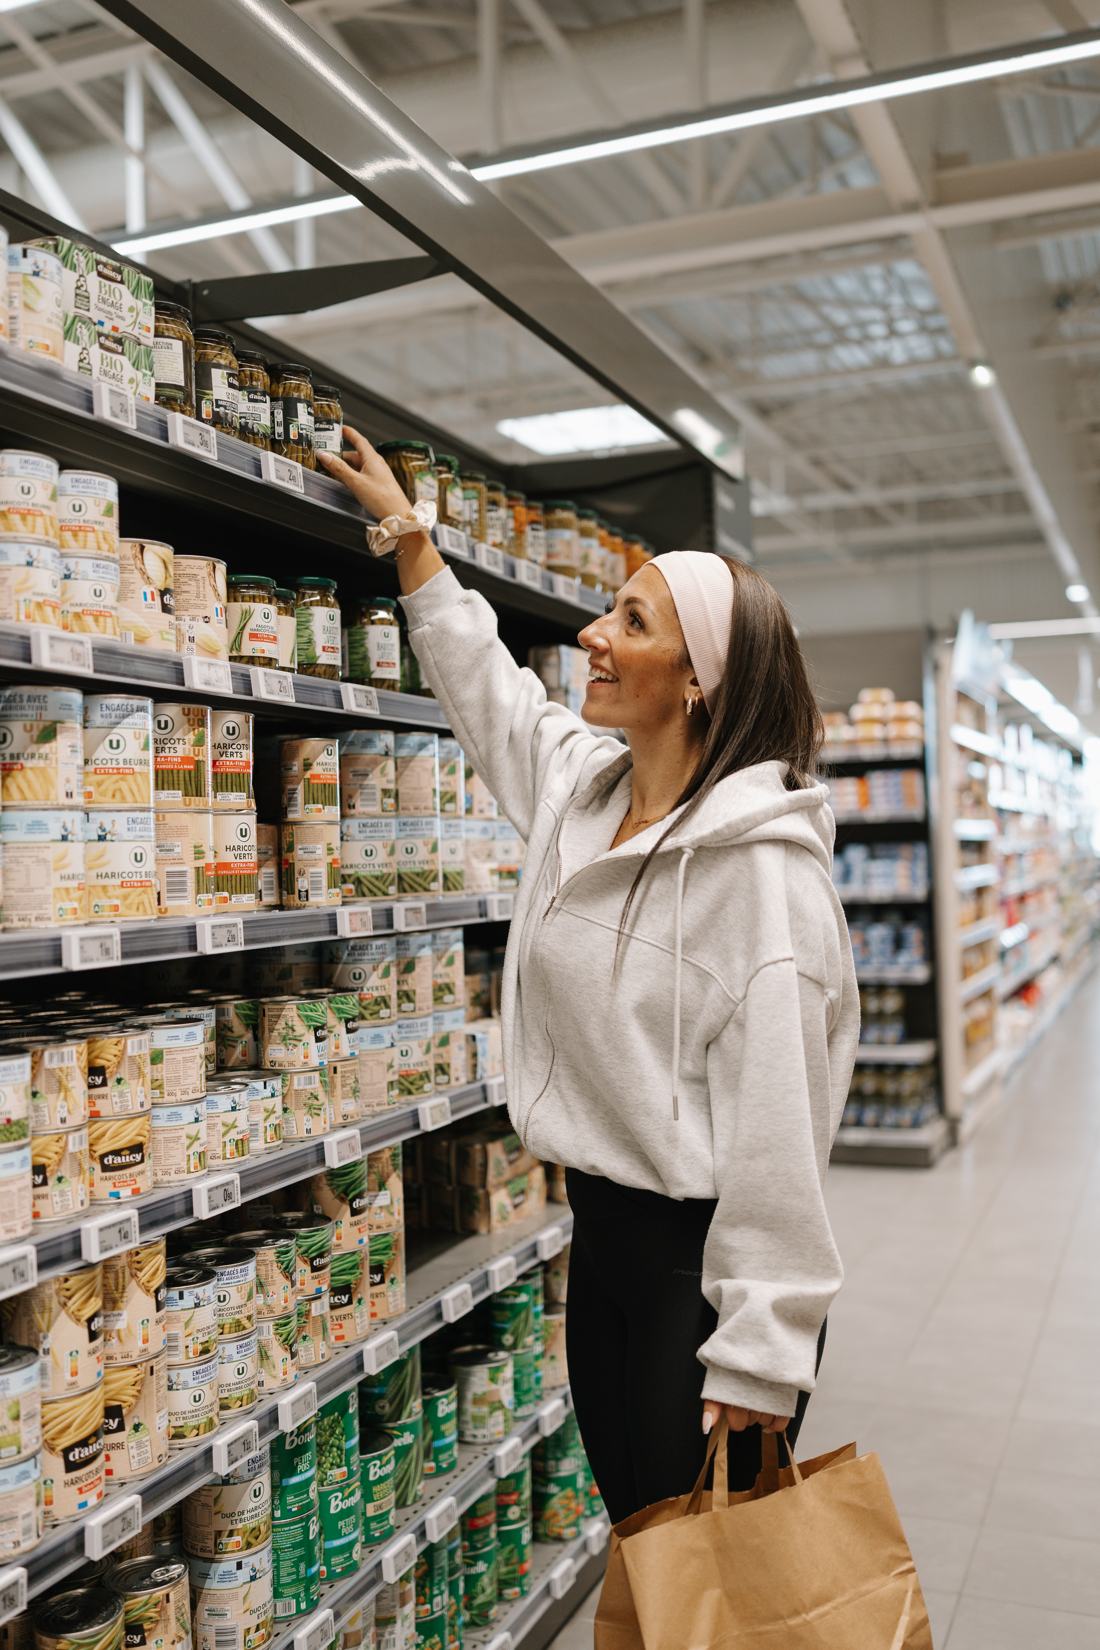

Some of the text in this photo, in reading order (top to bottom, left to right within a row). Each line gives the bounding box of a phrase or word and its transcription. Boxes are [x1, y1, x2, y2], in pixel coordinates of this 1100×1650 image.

[98, 281, 123, 301] BIO
[100, 352, 124, 373] BIO
[20, 486, 31, 496] U
[72, 503, 82, 513] U
[93, 588, 103, 598] U
[262, 611, 270, 620] U
[329, 613, 336, 622] U
[383, 631, 390, 639] U
[25, 694, 49, 705] AVEC
[99, 702, 135, 714] ENGAGÉS
[156, 719, 169, 731] U
[225, 725, 236, 736] U
[108, 738, 121, 750] U
[153, 736, 187, 746] RICOTS
[155, 746, 178, 754] ERTS
[212, 742, 249, 751] HARICOTS
[326, 746, 333, 757] U
[9, 752, 50, 761] BEURRE
[156, 756, 182, 764] RA-FINS
[218, 751, 243, 759] VERTS
[96, 767, 134, 775] EXTRA-FINS
[239, 826, 249, 838] U
[365, 848, 374, 858] U
[405, 846, 414, 856] U
[134, 851, 144, 863] U
[233, 852, 254, 861] VERTS
[96, 871, 144, 880] HARICOTS
[353, 971, 363, 981] U
[399, 1050, 409, 1059] U
[88, 1093, 109, 1101] EURRE
[103, 1151, 143, 1167] d'aucy
[99, 1173, 129, 1182] HARICOTS
[237, 1265, 249, 1275] AVEC
[217, 1293, 226, 1303] U
[370, 1291, 386, 1300] ERTS
[217, 1302, 248, 1314] RICOTS VERTS
[335, 1312, 354, 1322] VERTS
[192, 1364, 211, 1377] ENGAGÉS
[236, 1365, 246, 1376] U
[193, 1393, 202, 1403] U
[168, 1404, 209, 1418] DUO DE HARICOTS
[175, 1413, 181, 1421] ET
[181, 1411, 200, 1420] BEURRE
[285, 1426, 316, 1450] Bond
[293, 1451, 313, 1466] PETITS
[297, 1460, 311, 1474] POIS
[63, 1473, 94, 1489] HARICOTS
[253, 1486, 262, 1499] U
[329, 1492, 361, 1515] Bond
[221, 1511, 237, 1520] DUO
[237, 1509, 246, 1518] DE
[231, 1511, 261, 1527] ET BEURRE
[338, 1513, 357, 1530] PETITS
[341, 1524, 355, 1537] POIS
[249, 1606, 261, 1616] DUO
[256, 1613, 264, 1621] ET
